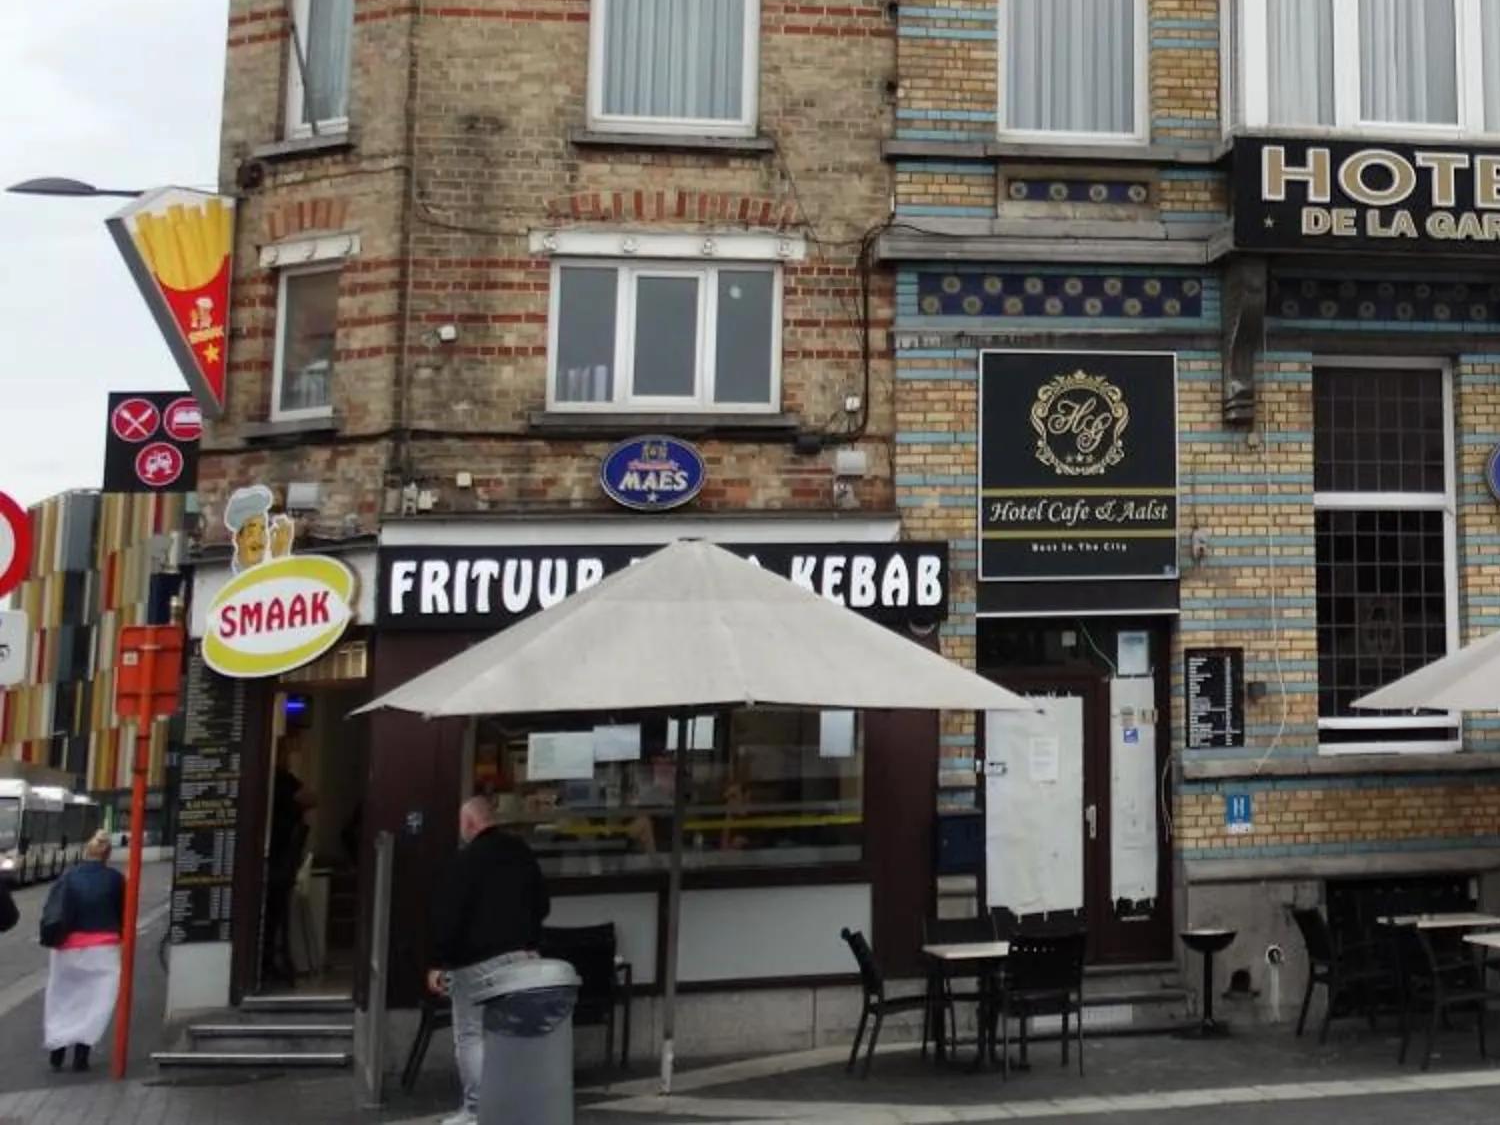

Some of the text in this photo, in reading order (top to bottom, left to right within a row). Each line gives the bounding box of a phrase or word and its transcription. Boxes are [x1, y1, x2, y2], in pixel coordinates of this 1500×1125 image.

[1301, 206, 1357, 237] DE
[1365, 208, 1418, 239] LA
[618, 470, 689, 492] MAES
[989, 499, 1048, 523] Hotel
[1048, 499, 1090, 527] Cafe
[1117, 499, 1168, 523] Aalst
[790, 552, 943, 608] KEBAB
[219, 590, 330, 639] SMAAK
